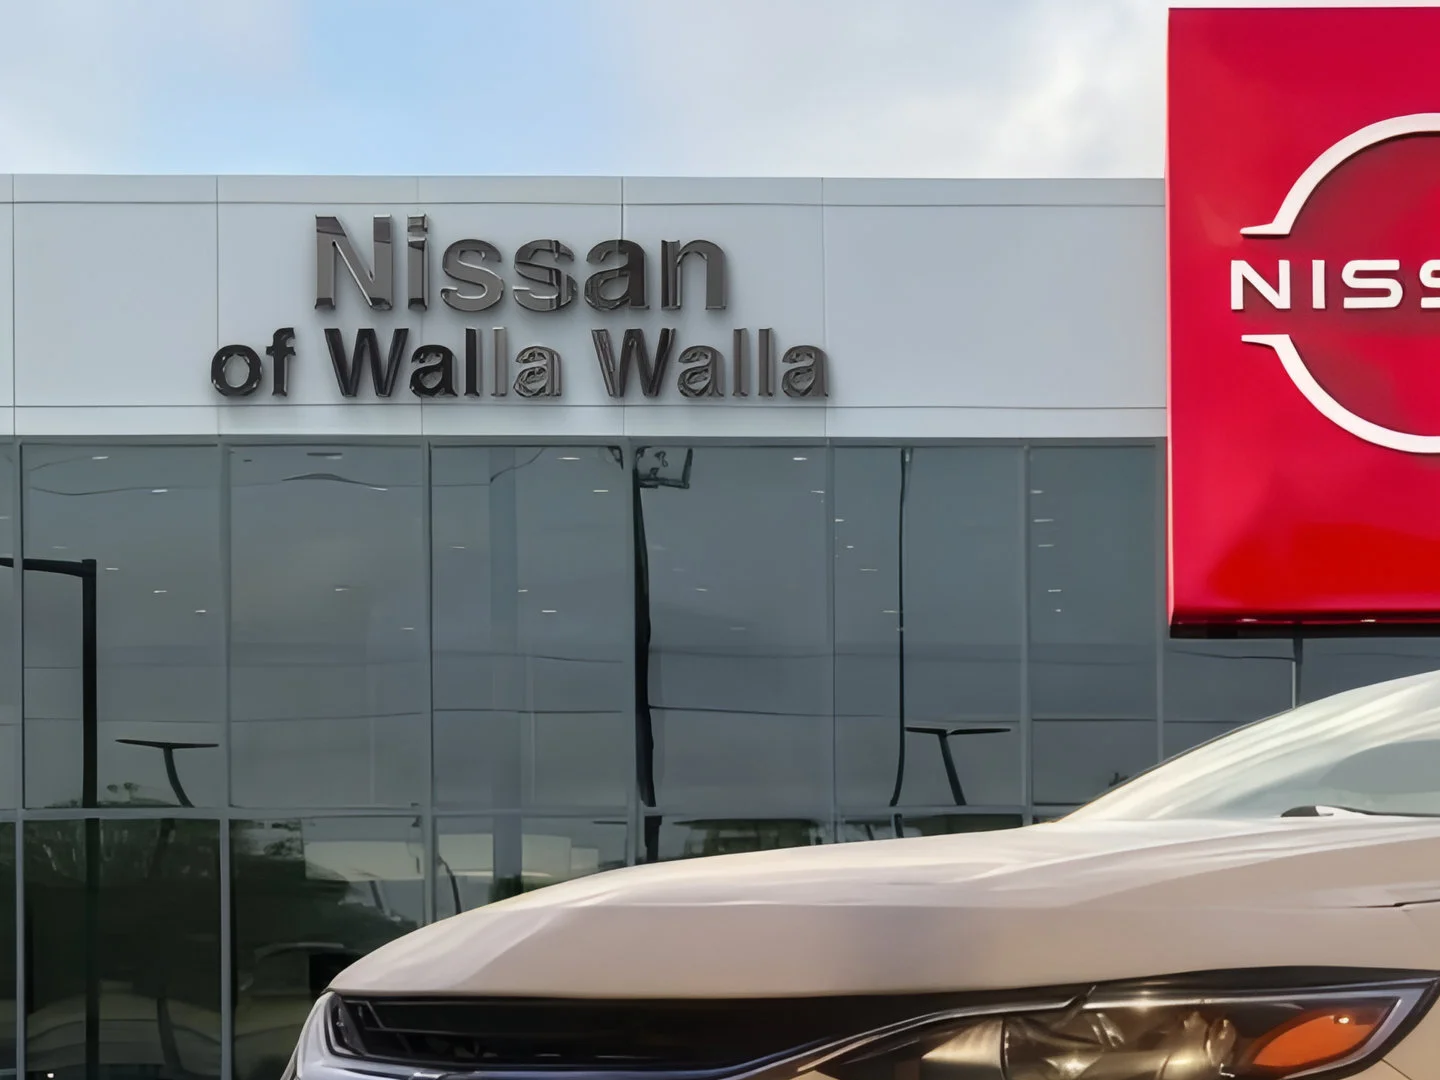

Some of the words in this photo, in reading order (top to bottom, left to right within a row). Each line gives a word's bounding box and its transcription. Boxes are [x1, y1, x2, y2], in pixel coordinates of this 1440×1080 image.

[314, 213, 728, 312] Nissan
[209, 326, 297, 398] of
[323, 326, 563, 399] Walla
[590, 326, 830, 399] Walla
